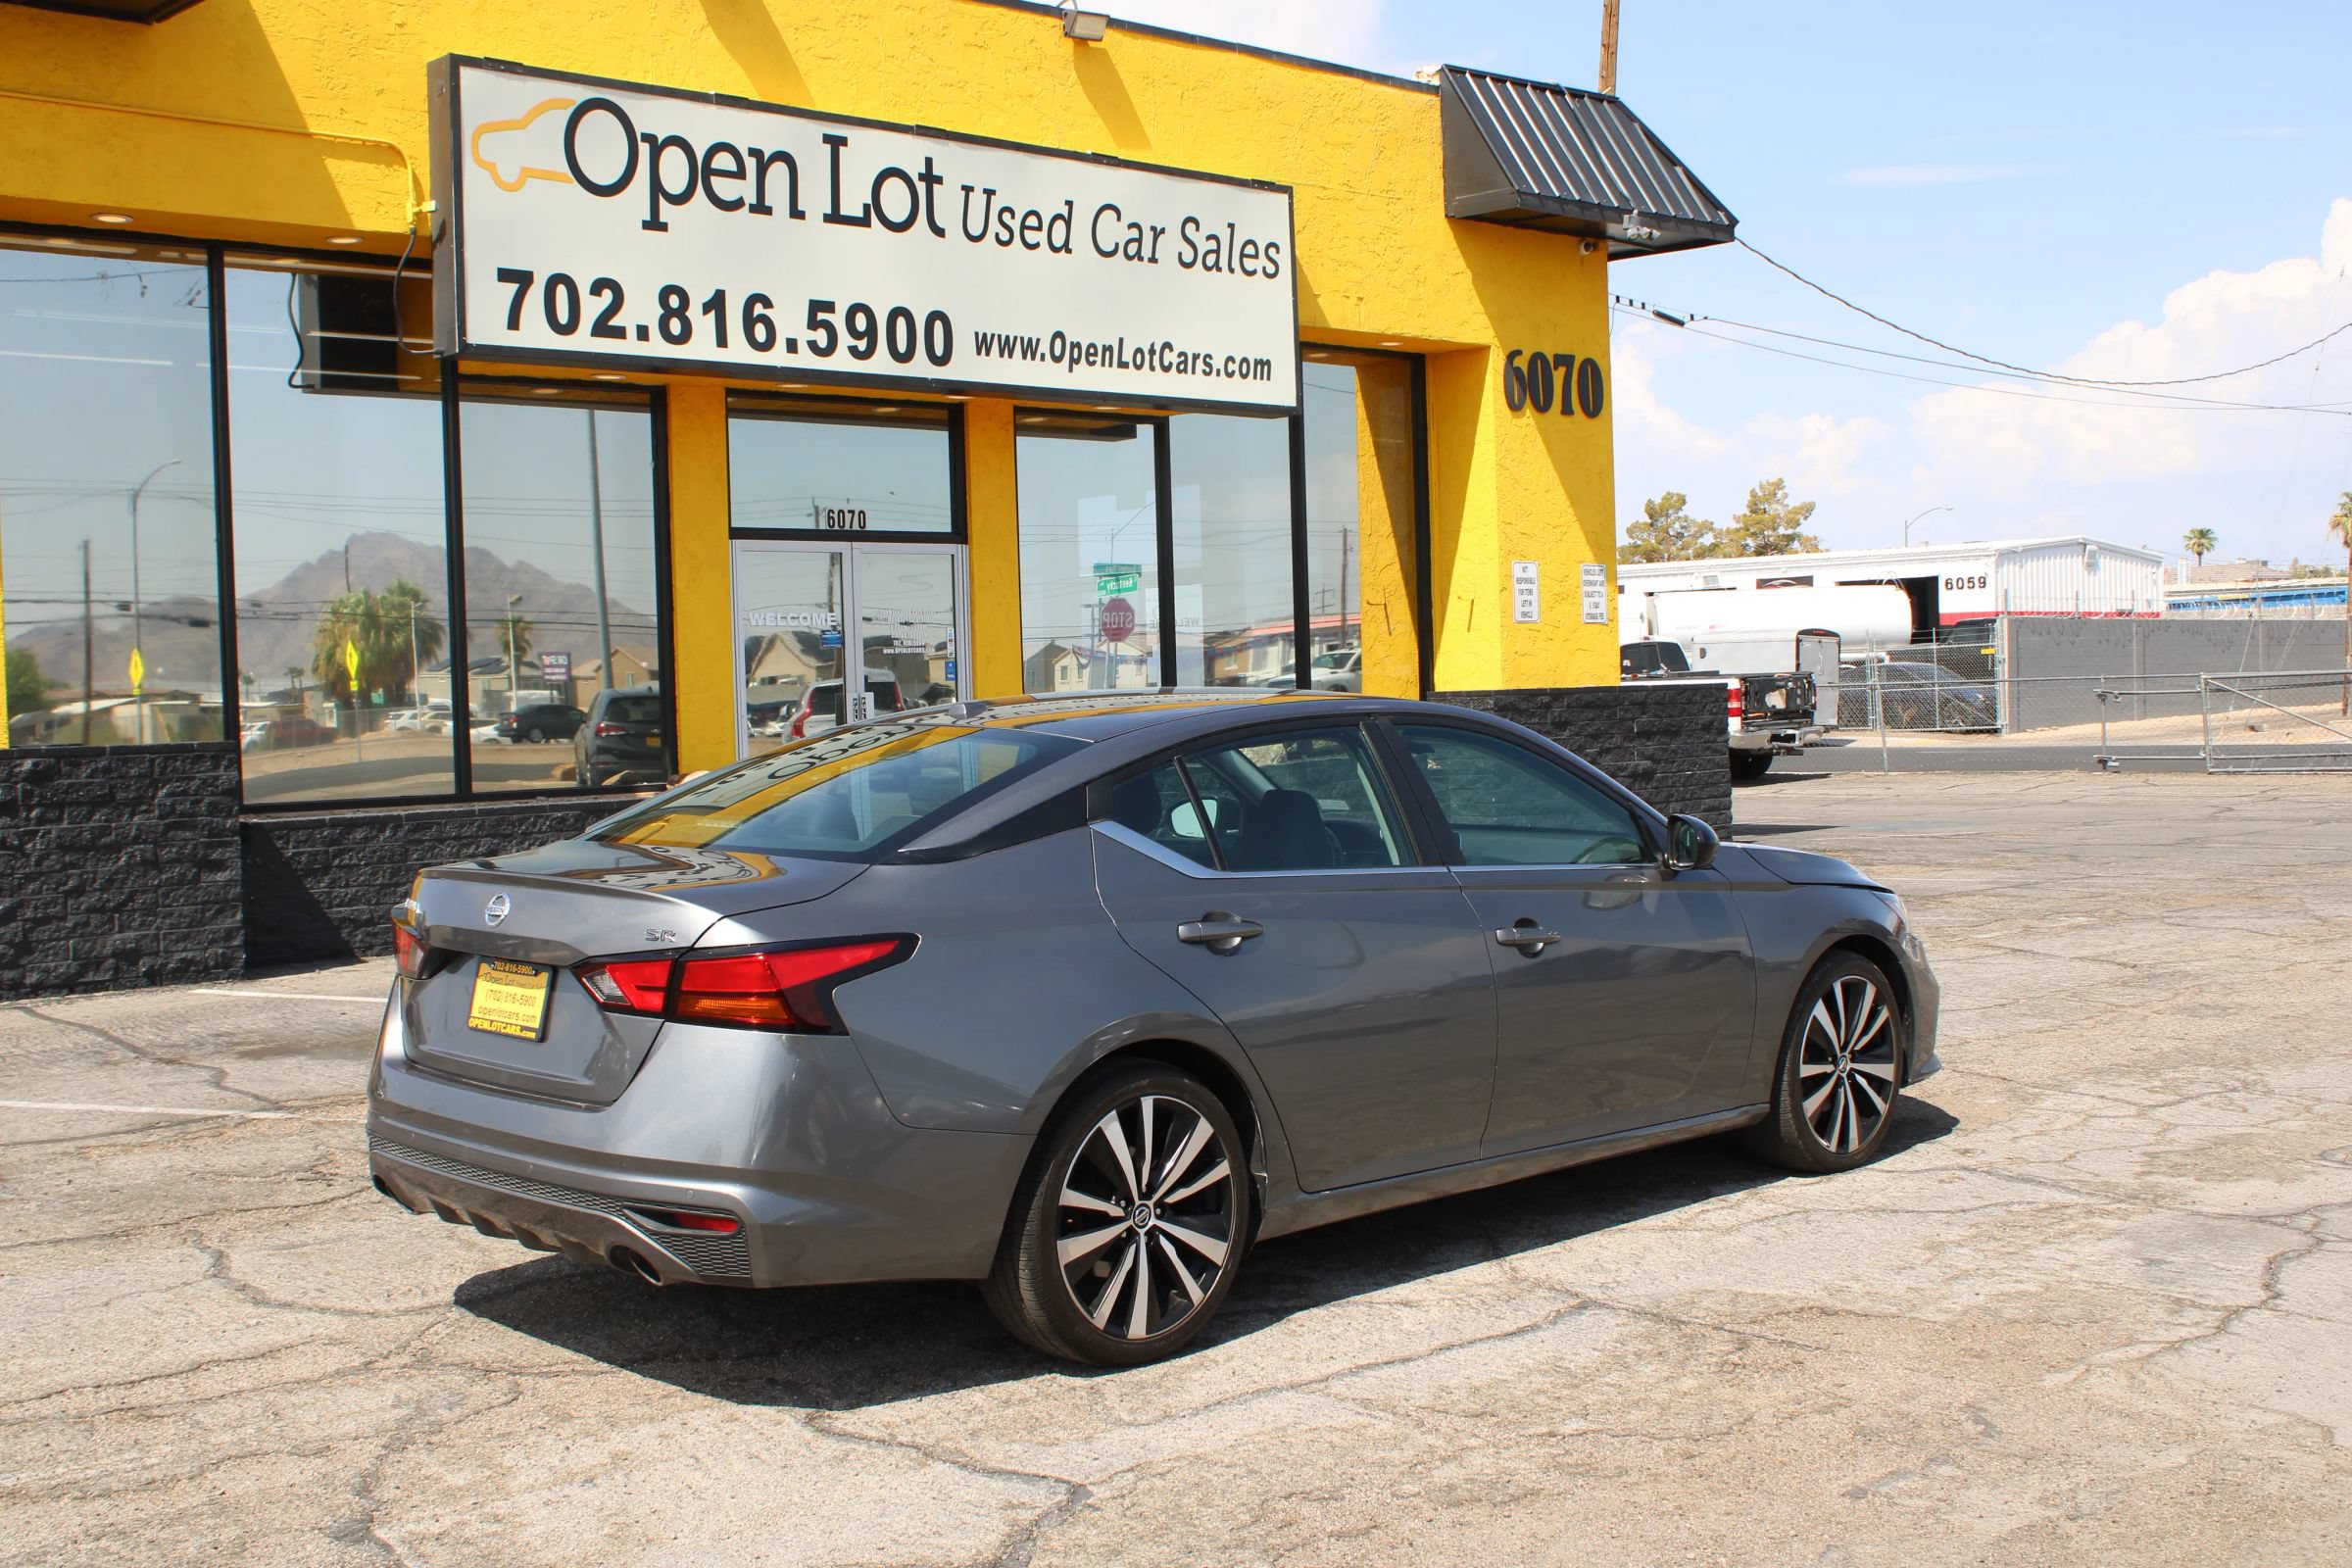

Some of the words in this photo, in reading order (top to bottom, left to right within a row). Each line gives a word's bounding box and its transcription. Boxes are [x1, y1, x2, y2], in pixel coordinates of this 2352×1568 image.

[564, 97, 806, 232] Open
[822, 133, 947, 238] Lot
[960, 184, 1074, 255] Used
[1091, 203, 1165, 264] Car
[1177, 216, 1281, 279] Sales
[496, 266, 954, 368] 702.816.5900
[974, 330, 1272, 381] www.OpenLotCars.com
[1504, 348, 1604, 419] 6070
[826, 509, 866, 530] 6070
[1944, 576, 1986, 590] 6059
[749, 612, 838, 626] WELCOME
[645, 928, 676, 943] SR
[493, 961, 534, 975] 702-816-5900
[467, 1017, 536, 1040] OPENLOTCARS.com
